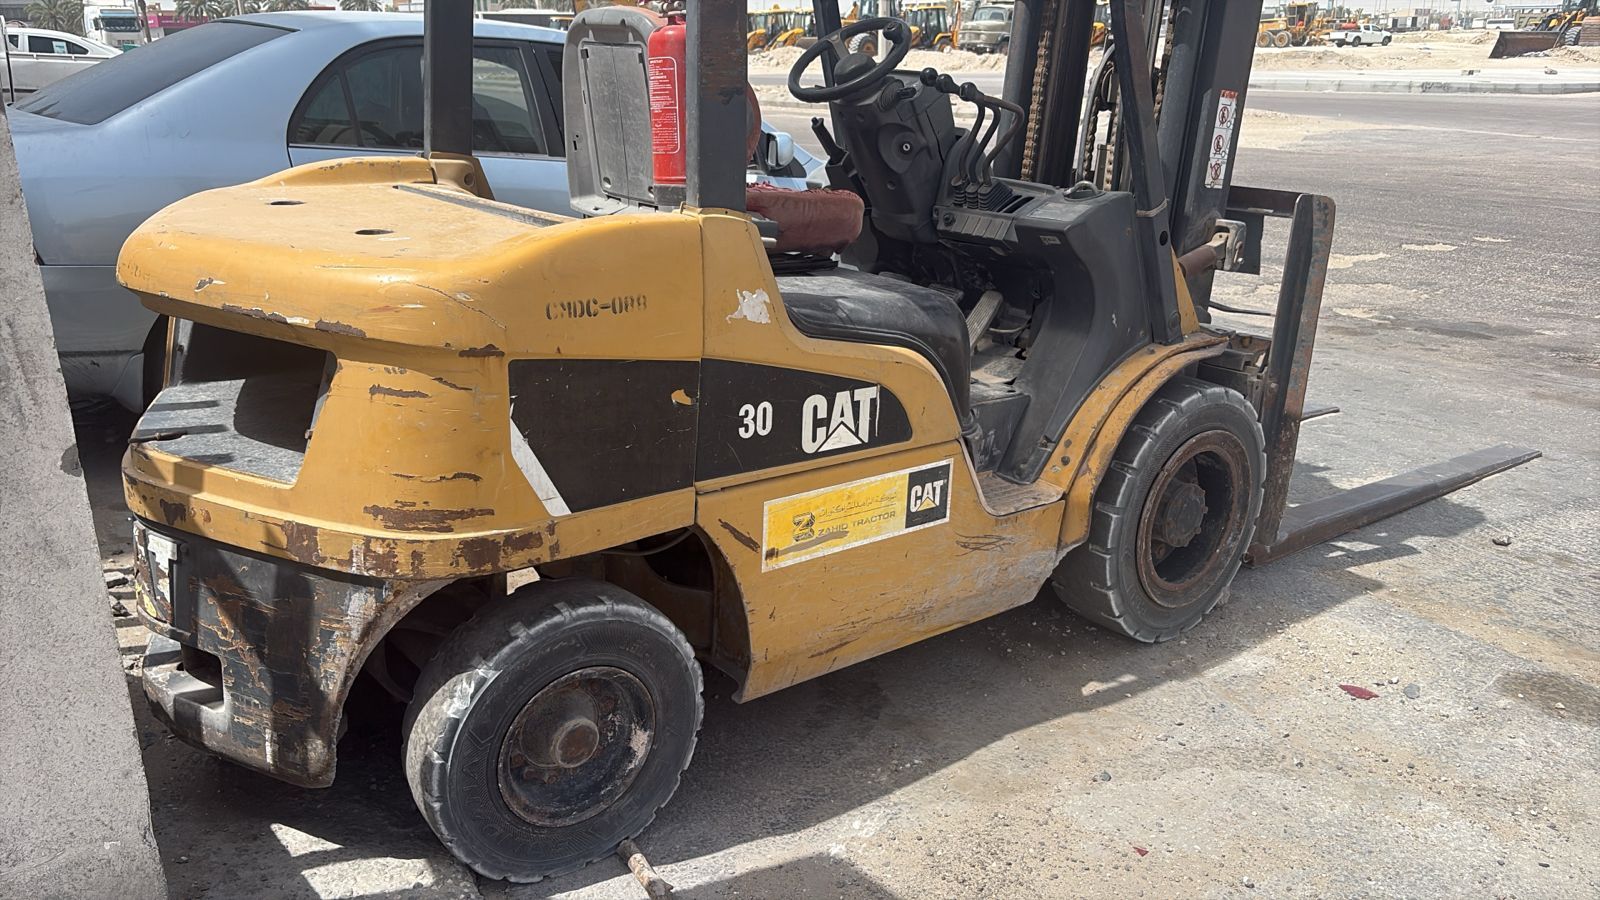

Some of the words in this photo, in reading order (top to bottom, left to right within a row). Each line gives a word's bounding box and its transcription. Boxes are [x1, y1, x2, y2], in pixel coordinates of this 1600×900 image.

[738, 401, 773, 439] 30
[802, 386, 877, 454] CAT
[910, 479, 945, 513] CAT
[852, 510, 896, 527] TRACTOR
